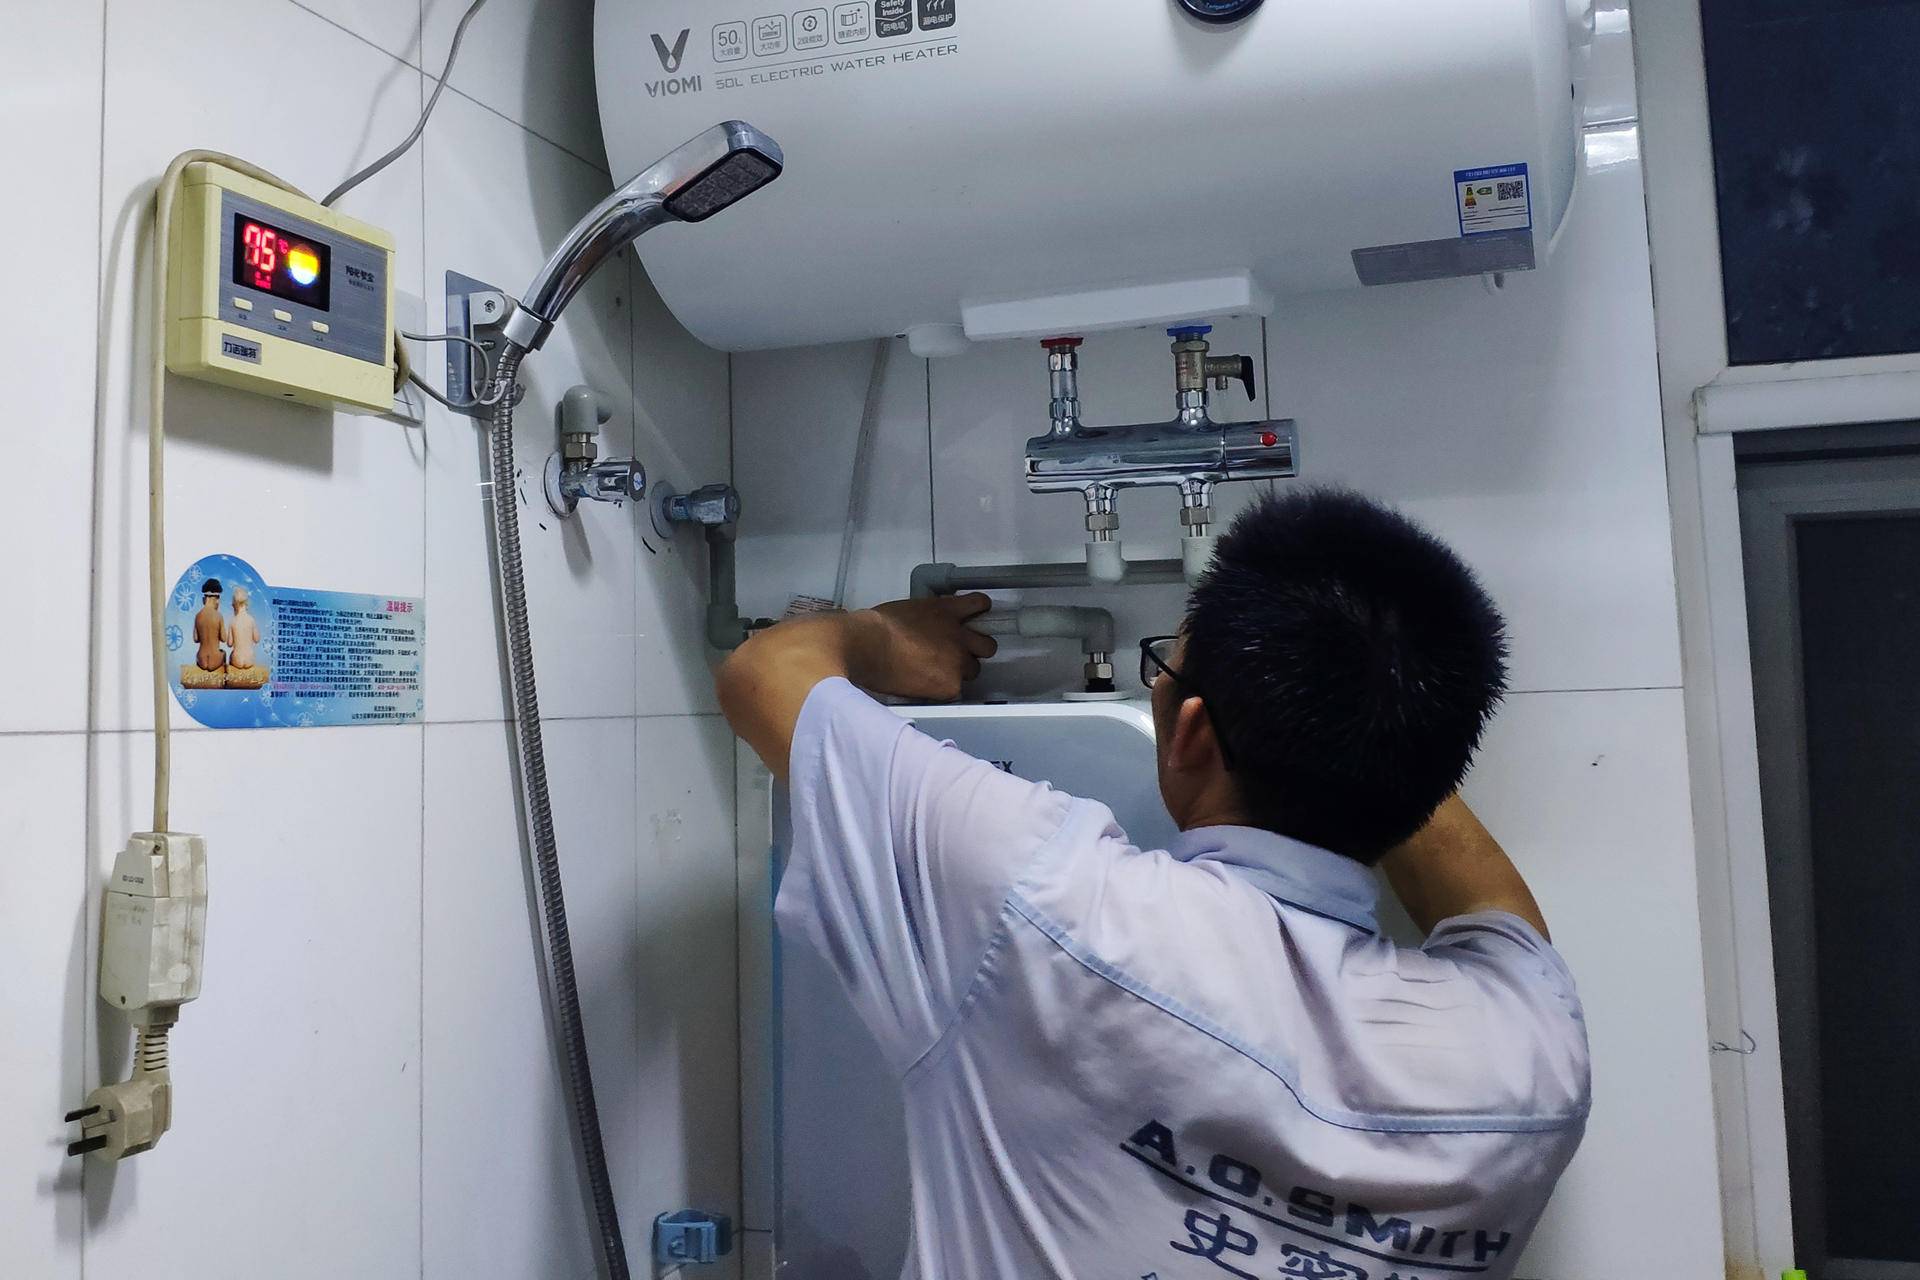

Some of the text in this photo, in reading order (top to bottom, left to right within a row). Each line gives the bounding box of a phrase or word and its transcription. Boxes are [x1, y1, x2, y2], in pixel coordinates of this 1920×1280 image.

[882, 7, 904, 16] Inside
[751, 65, 824, 84] ELECTRIC
[831, 56, 885, 72] WATER
[893, 44, 958, 62] HEATER
[645, 75, 702, 98] VIOMI
